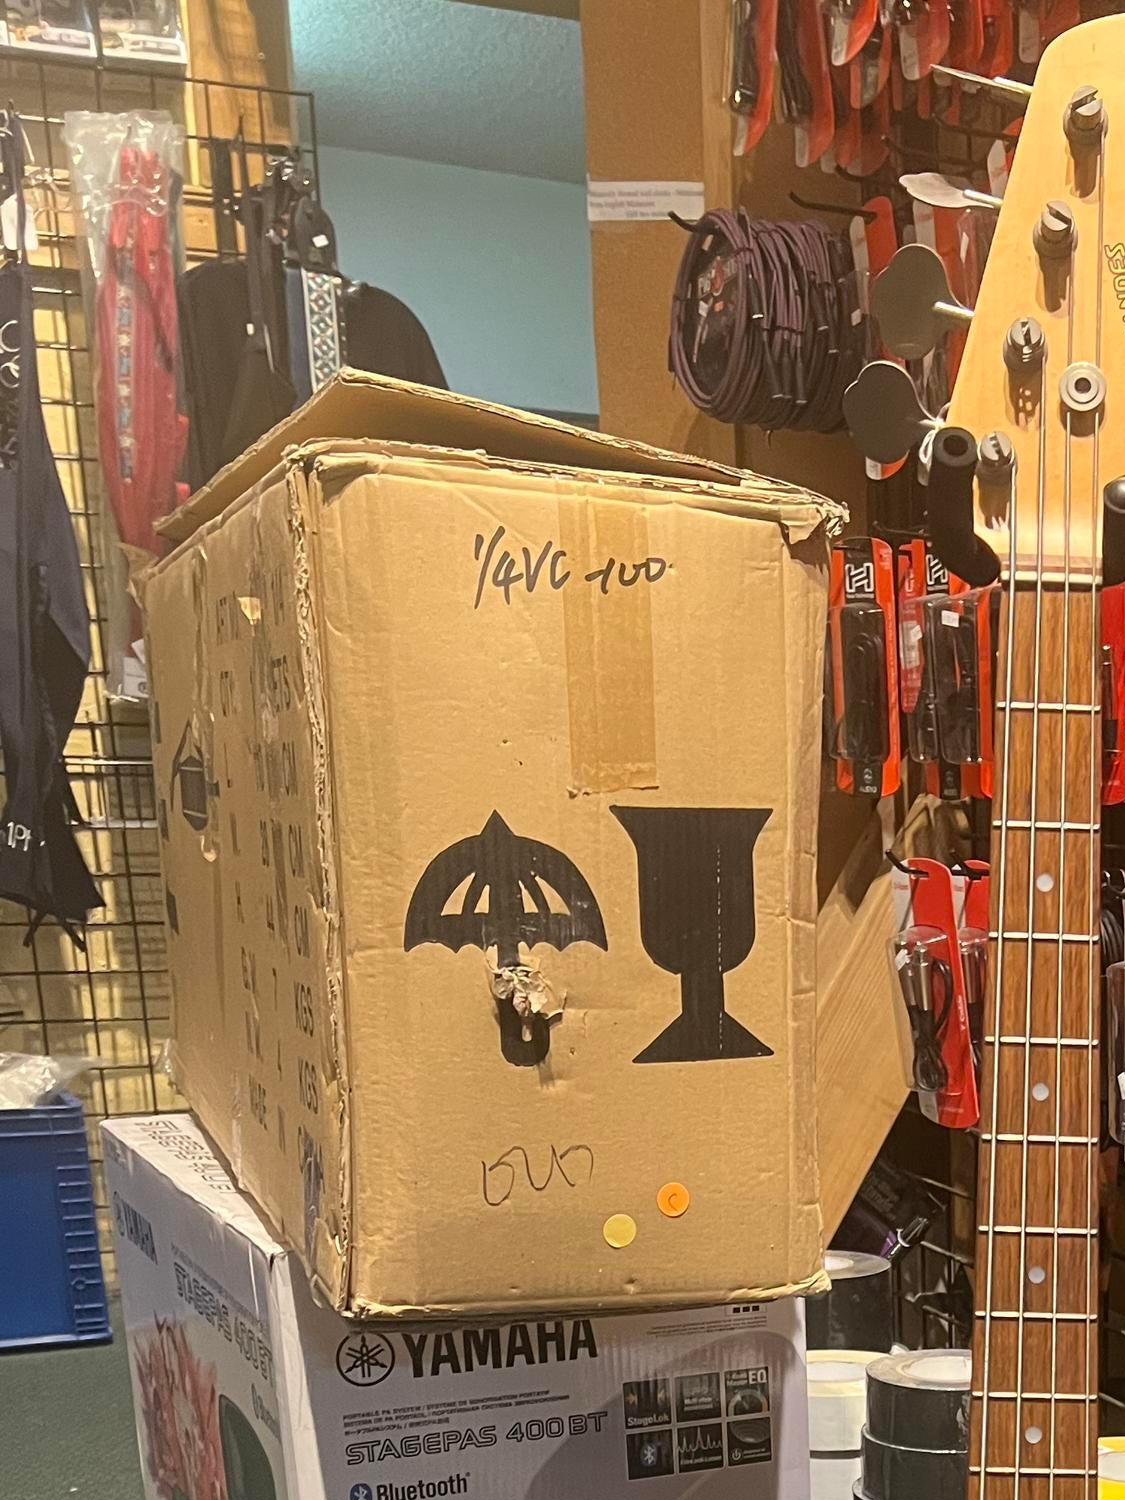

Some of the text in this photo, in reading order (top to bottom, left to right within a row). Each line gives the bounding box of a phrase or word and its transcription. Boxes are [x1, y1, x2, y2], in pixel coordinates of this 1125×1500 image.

[287, 822, 305, 878] CM
[293, 903, 311, 960] CM
[292, 979, 316, 1039] KGS
[297, 1055, 320, 1117] KGS
[402, 1319, 599, 1378] YAMAHA
[749, 1369, 768, 1385] EQ
[346, 1425, 497, 1466] STAGEPAS
